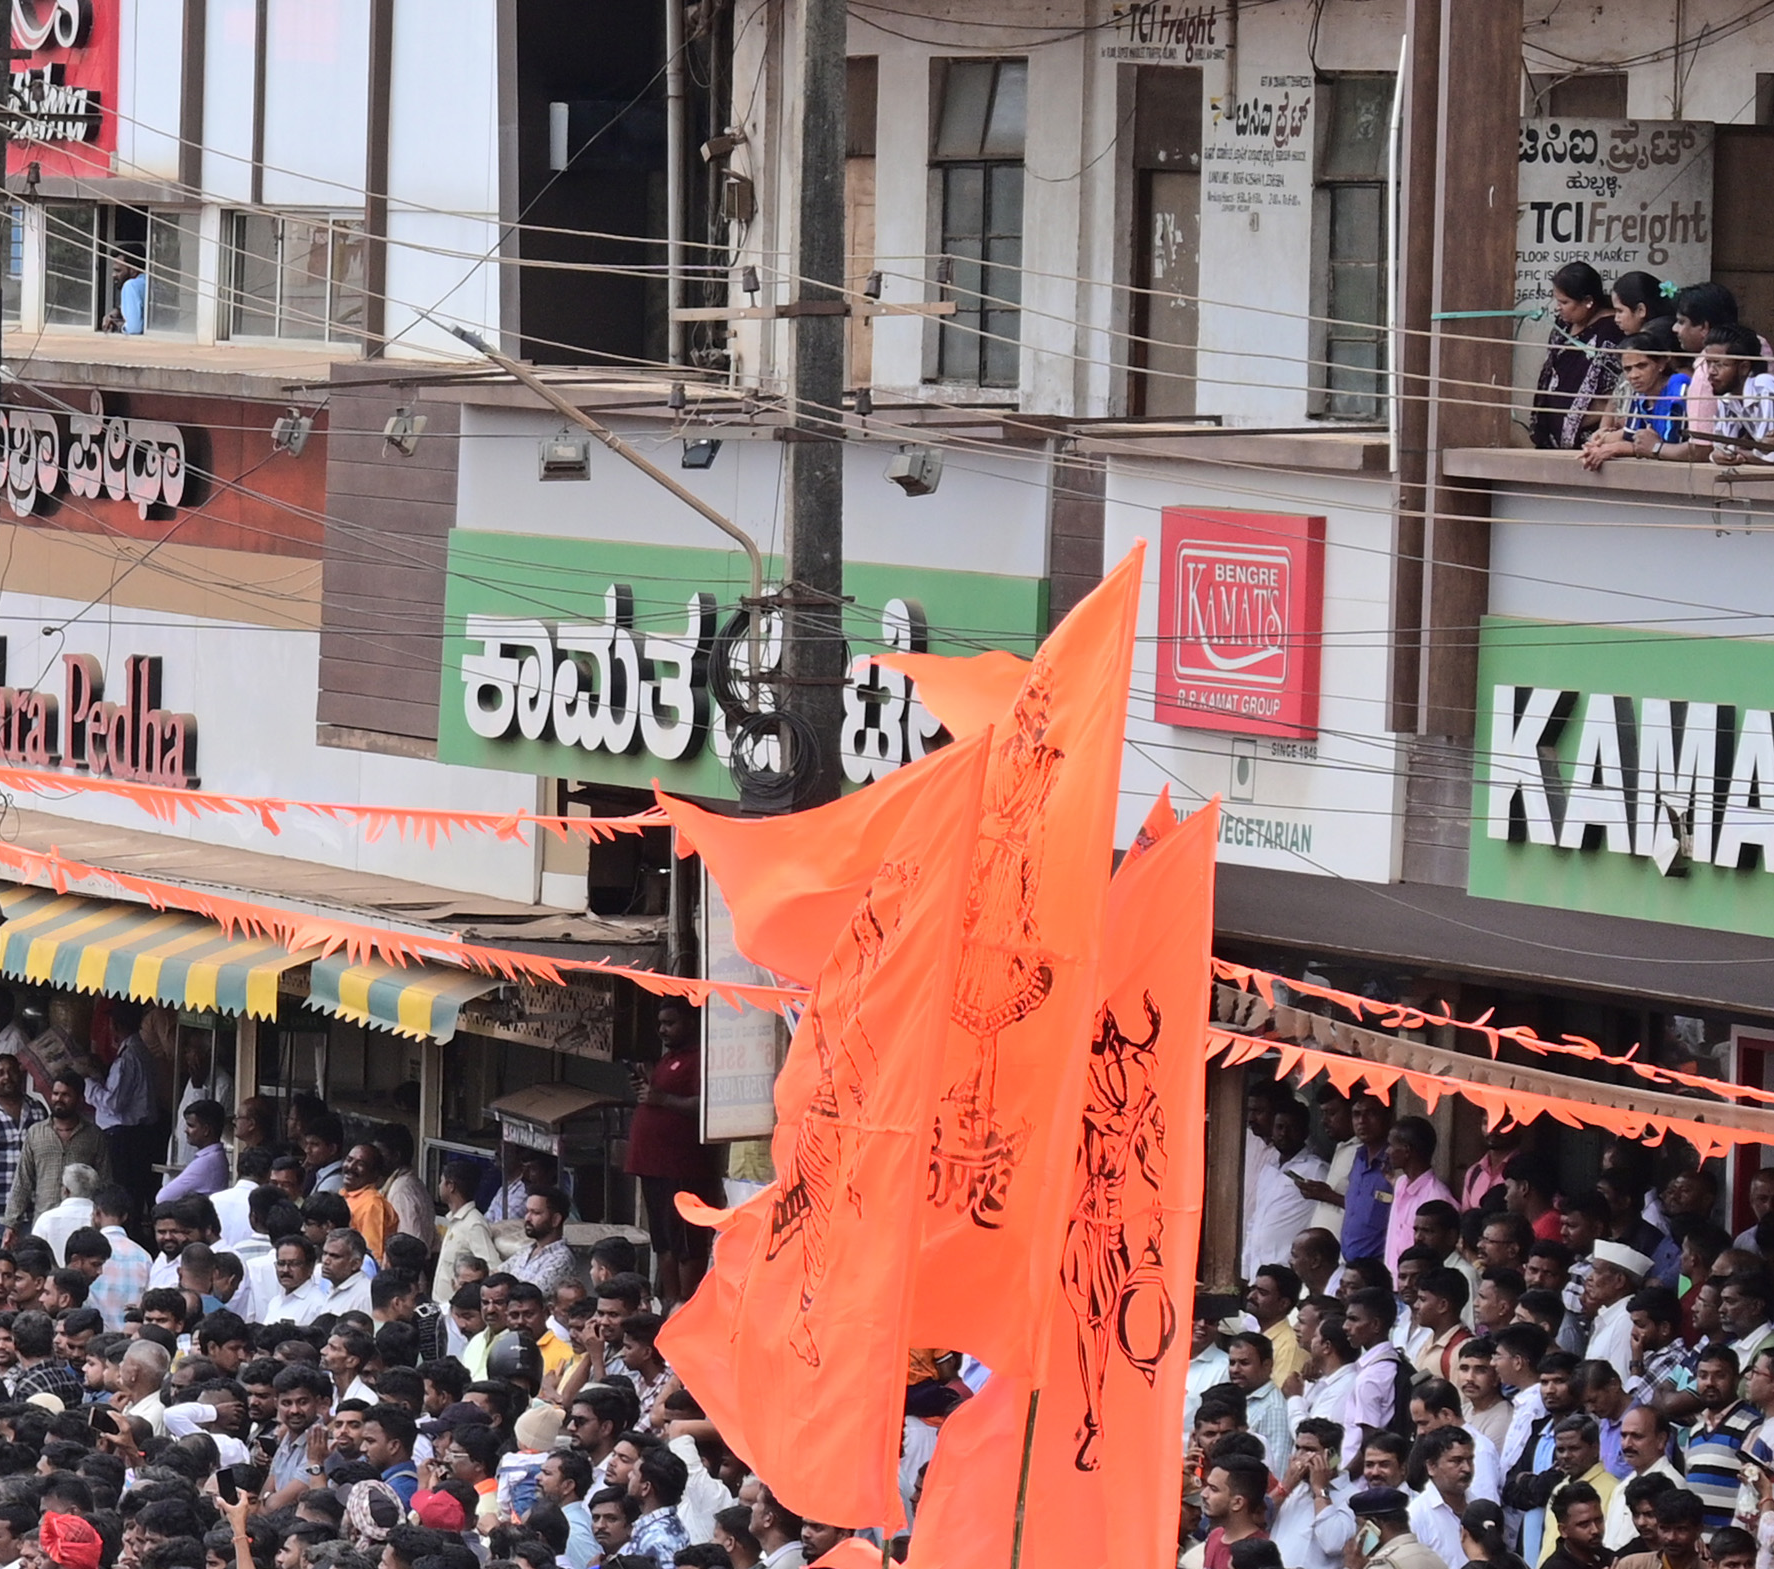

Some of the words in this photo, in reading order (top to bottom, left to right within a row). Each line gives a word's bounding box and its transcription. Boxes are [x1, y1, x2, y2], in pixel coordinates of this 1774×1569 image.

[1130, 3, 1155, 42] TCI
[1159, 5, 1216, 62] Freight
[1530, 201, 1584, 244] TCI
[1588, 200, 1708, 266] Freight
[1515, 250, 1550, 263] FLOOR
[1554, 250, 1589, 263] SUPER
[1594, 247, 1640, 263] MARKET
[1215, 563, 1279, 588] BENGRE
[1186, 562, 1284, 660] KAMAT'S
[61, 652, 198, 790] Pedha
[1199, 692, 1240, 713] KAMAT
[1241, 694, 1282, 717] GROUP
[1271, 741, 1298, 759] SINCE
[1217, 814, 1313, 853] VEGETARIAN
